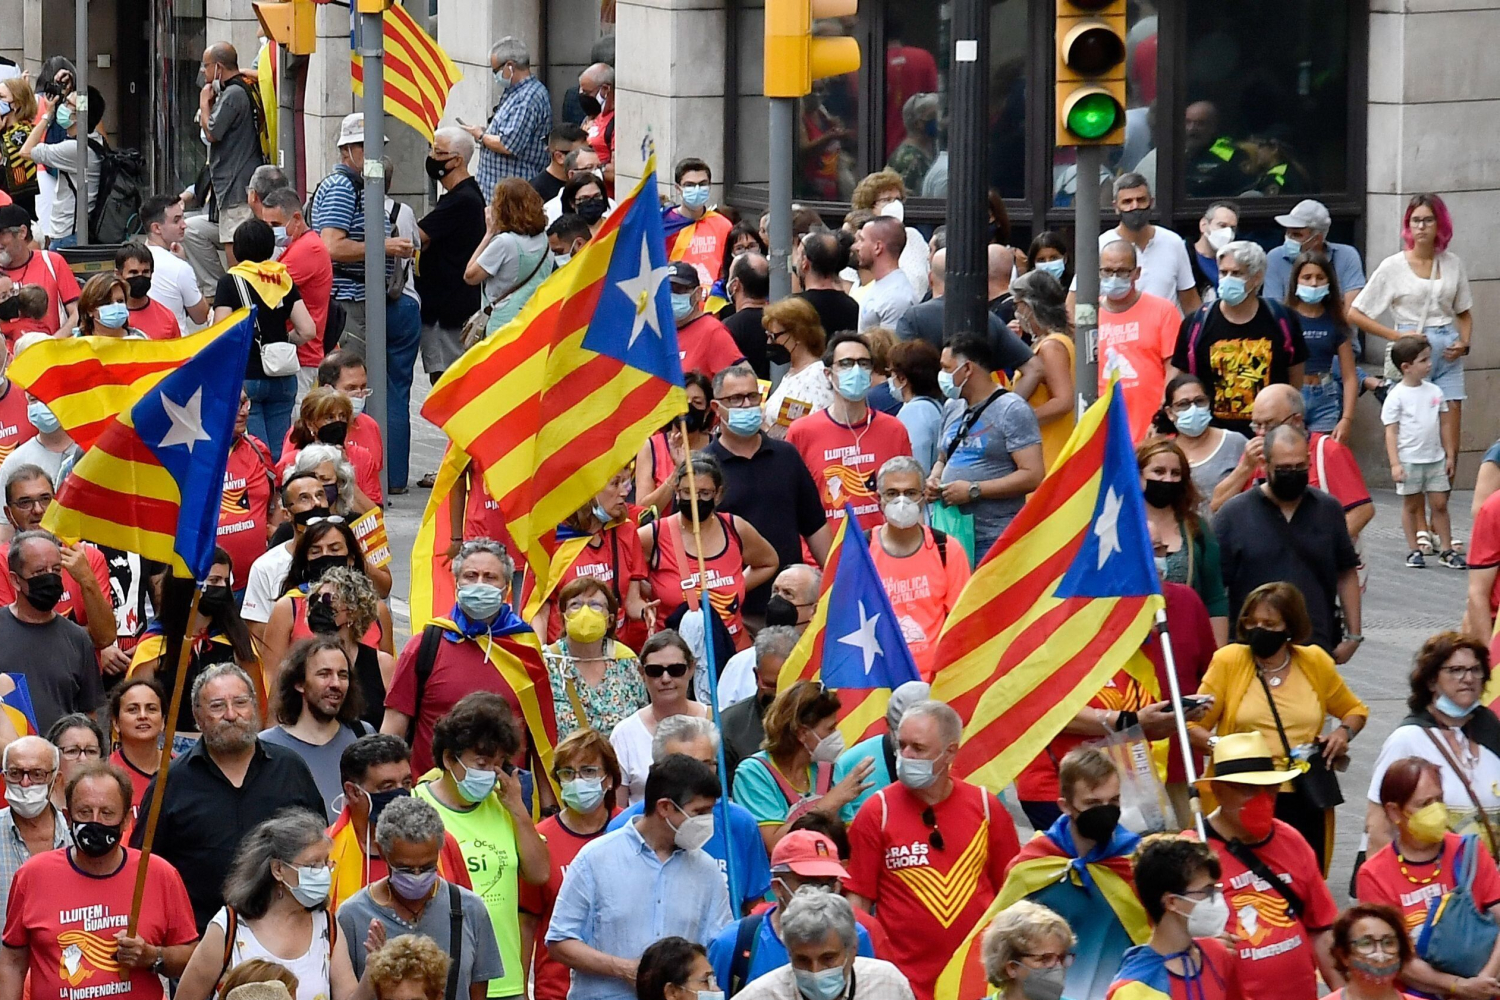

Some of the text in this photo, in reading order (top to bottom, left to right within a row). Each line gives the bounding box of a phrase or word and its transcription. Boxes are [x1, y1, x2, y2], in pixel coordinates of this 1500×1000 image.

[886, 841, 929, 859] ARA ÉS
[467, 854, 488, 873] Sí
[60, 904, 109, 924] LLUITEM I
[83, 912, 128, 932] GUANYEM
[59, 980, 132, 1000] LA INDEPENDÈNCIA
